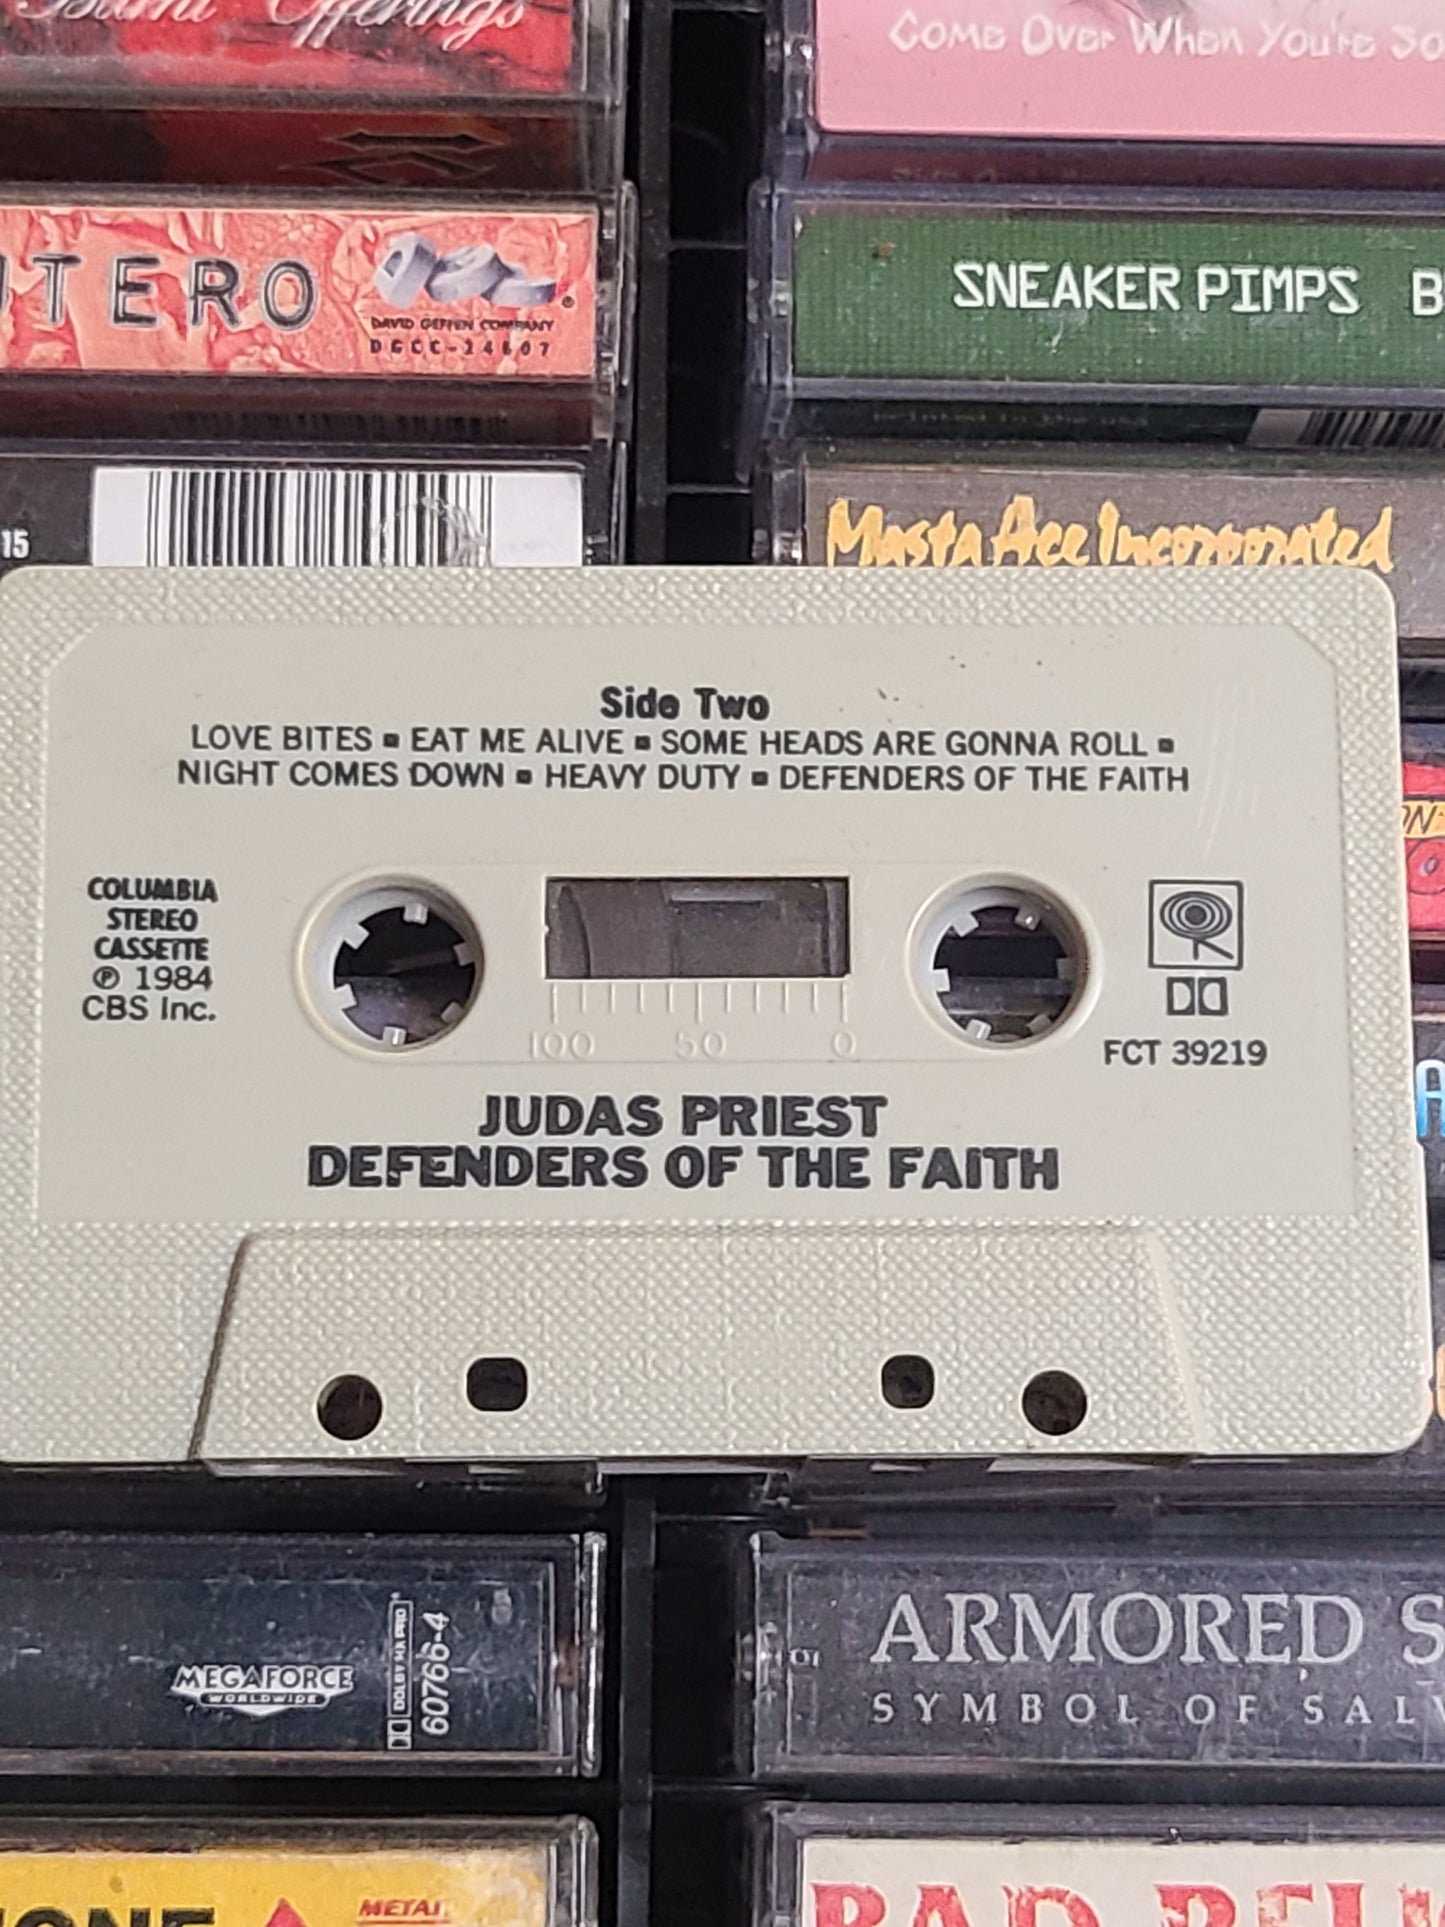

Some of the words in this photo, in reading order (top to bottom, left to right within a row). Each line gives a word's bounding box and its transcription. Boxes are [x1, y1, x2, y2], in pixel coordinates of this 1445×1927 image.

[1129, 15, 1244, 57] When
[1257, 17, 1377, 59] You're
[0, 253, 320, 332] TERO
[953, 261, 1182, 312] SNEAKER
[1196, 264, 1361, 316] PIMPS
[371, 315, 415, 331] DAVID
[420, 317, 474, 332] GEFFEN
[479, 318, 554, 332] COMPANY
[993, 495, 1089, 566] Ace
[1098, 501, 1394, 573] Incorporated
[600, 685, 680, 719] Side
[694, 687, 770, 720] Two
[191, 723, 272, 750] LOVE
[283, 725, 372, 751] BITES
[411, 726, 469, 752] EAT
[480, 727, 525, 753] ME
[536, 727, 624, 754] ALIVE
[661, 728, 748, 755] SOME
[760, 729, 863, 755] HEADS
[873, 730, 936, 756] ARE
[945, 730, 1059, 756] GONNA
[1070, 731, 1148, 757] ROLL
[178, 759, 280, 786] NIGHT
[289, 760, 399, 787] COMES
[409, 761, 504, 788] DOWN
[546, 763, 646, 789] HEAVY
[658, 763, 740, 789] DUTY
[780, 763, 965, 791] DEFENDERS
[974, 765, 1017, 791] OF
[1025, 765, 1088, 791] THE
[1099, 766, 1190, 792] FAITH
[87, 876, 219, 903] COLUMBIA
[106, 907, 199, 932] STEREO
[94, 936, 209, 961] CASSETTE
[136, 965, 213, 991] 1984
[82, 994, 149, 1021] CBS
[161, 996, 217, 1021] Inc.
[531, 1030, 595, 1059] 100
[675, 1030, 726, 1059] 50
[1104, 1039, 1162, 1066] FCT
[1172, 1039, 1268, 1067] 39219
[478, 1094, 663, 1137] JUDAS
[681, 1094, 888, 1138] PRIEST
[307, 1144, 649, 1188] DEFENDERS
[664, 1145, 743, 1189] OF
[757, 1146, 871, 1189] THE
[888, 1146, 1060, 1190] FAITH
[394, 1608, 407, 1639] PRO
[869, 1591, 1364, 1665] ARMORED
[174, 1665, 355, 1690] MEGAFORCE
[393, 1664, 407, 1712] DOLBY
[421, 1611, 451, 1736] 60766-4
[208, 1692, 318, 1705] WORLDWIDE
[872, 1692, 1138, 1725] SYMBOL
[1184, 1693, 1258, 1725] OF
